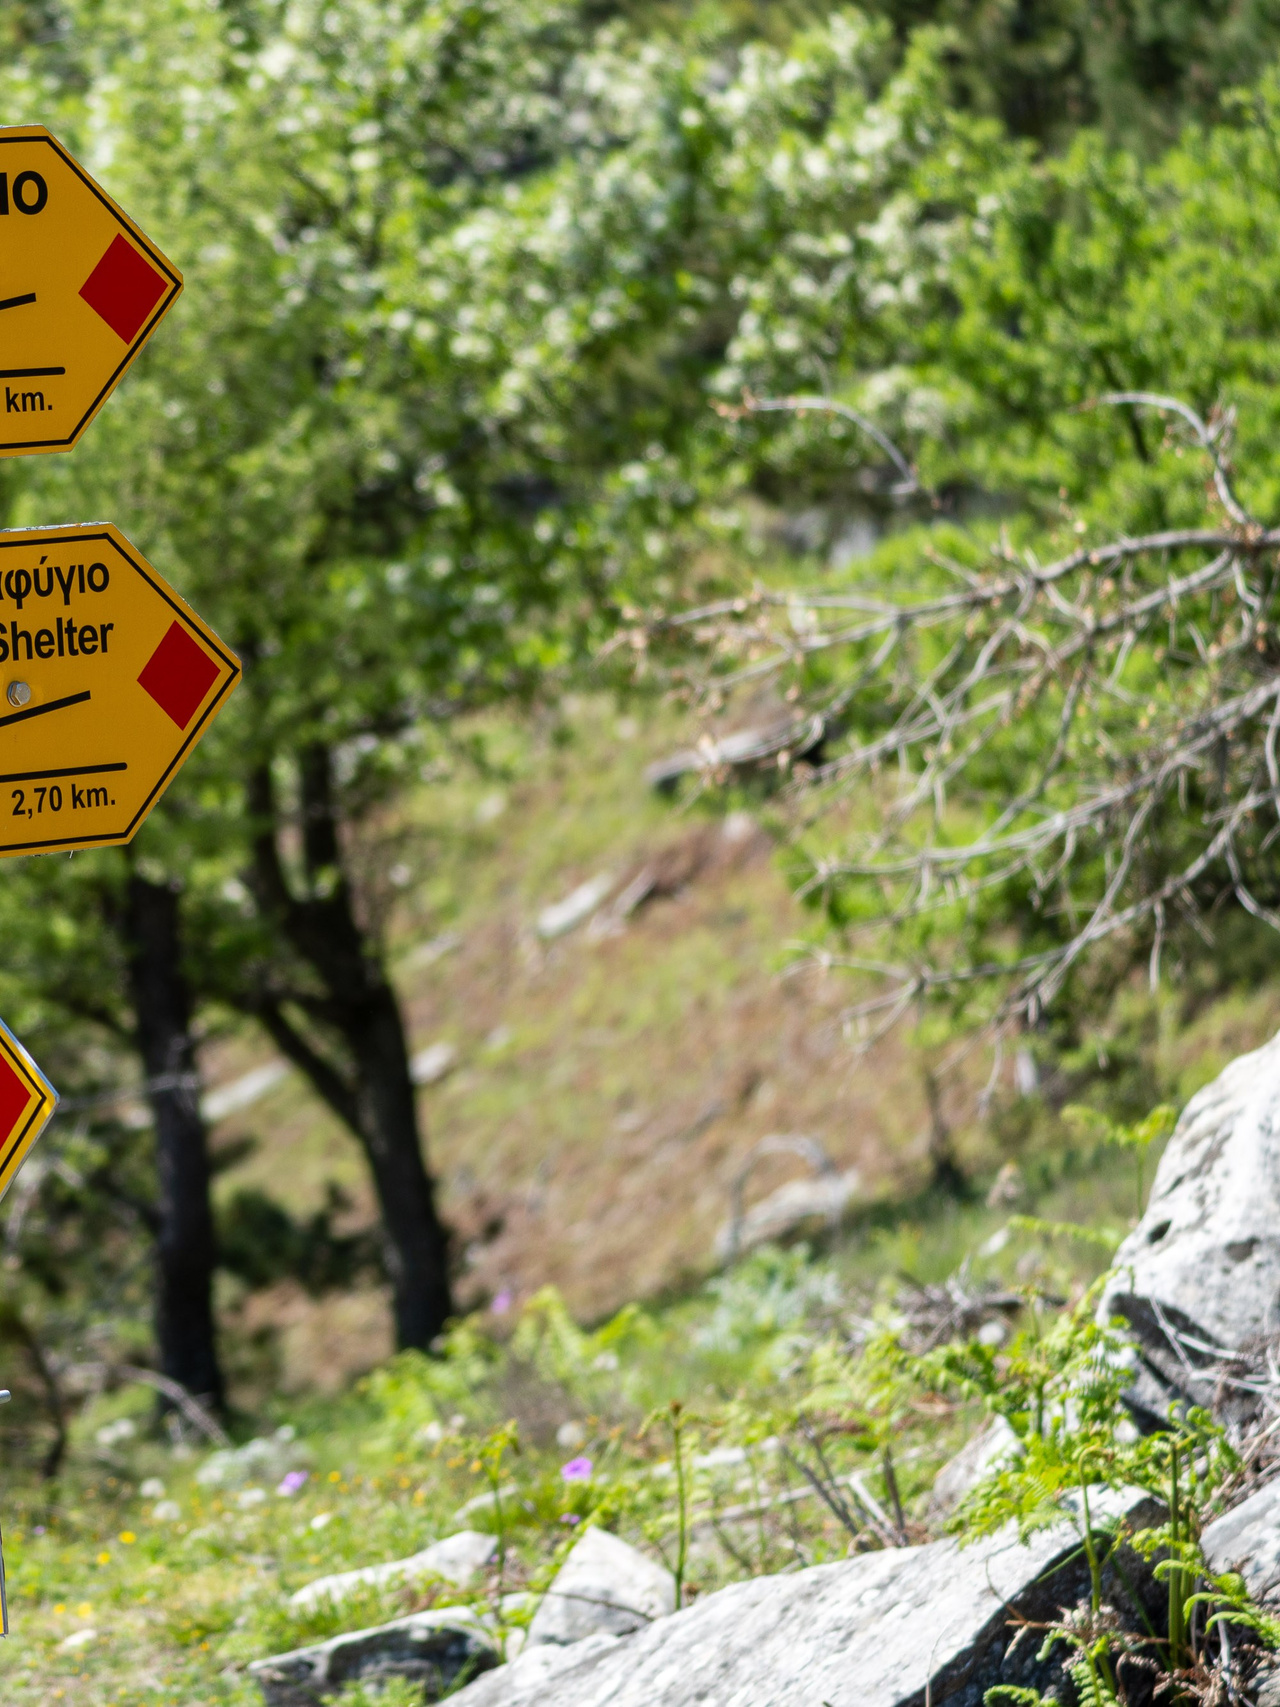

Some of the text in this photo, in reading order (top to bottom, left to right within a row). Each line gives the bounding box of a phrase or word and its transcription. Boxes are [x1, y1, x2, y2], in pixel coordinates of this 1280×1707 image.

[6, 387, 52, 412] km.
[12, 784, 115, 819] 2,70 km.
